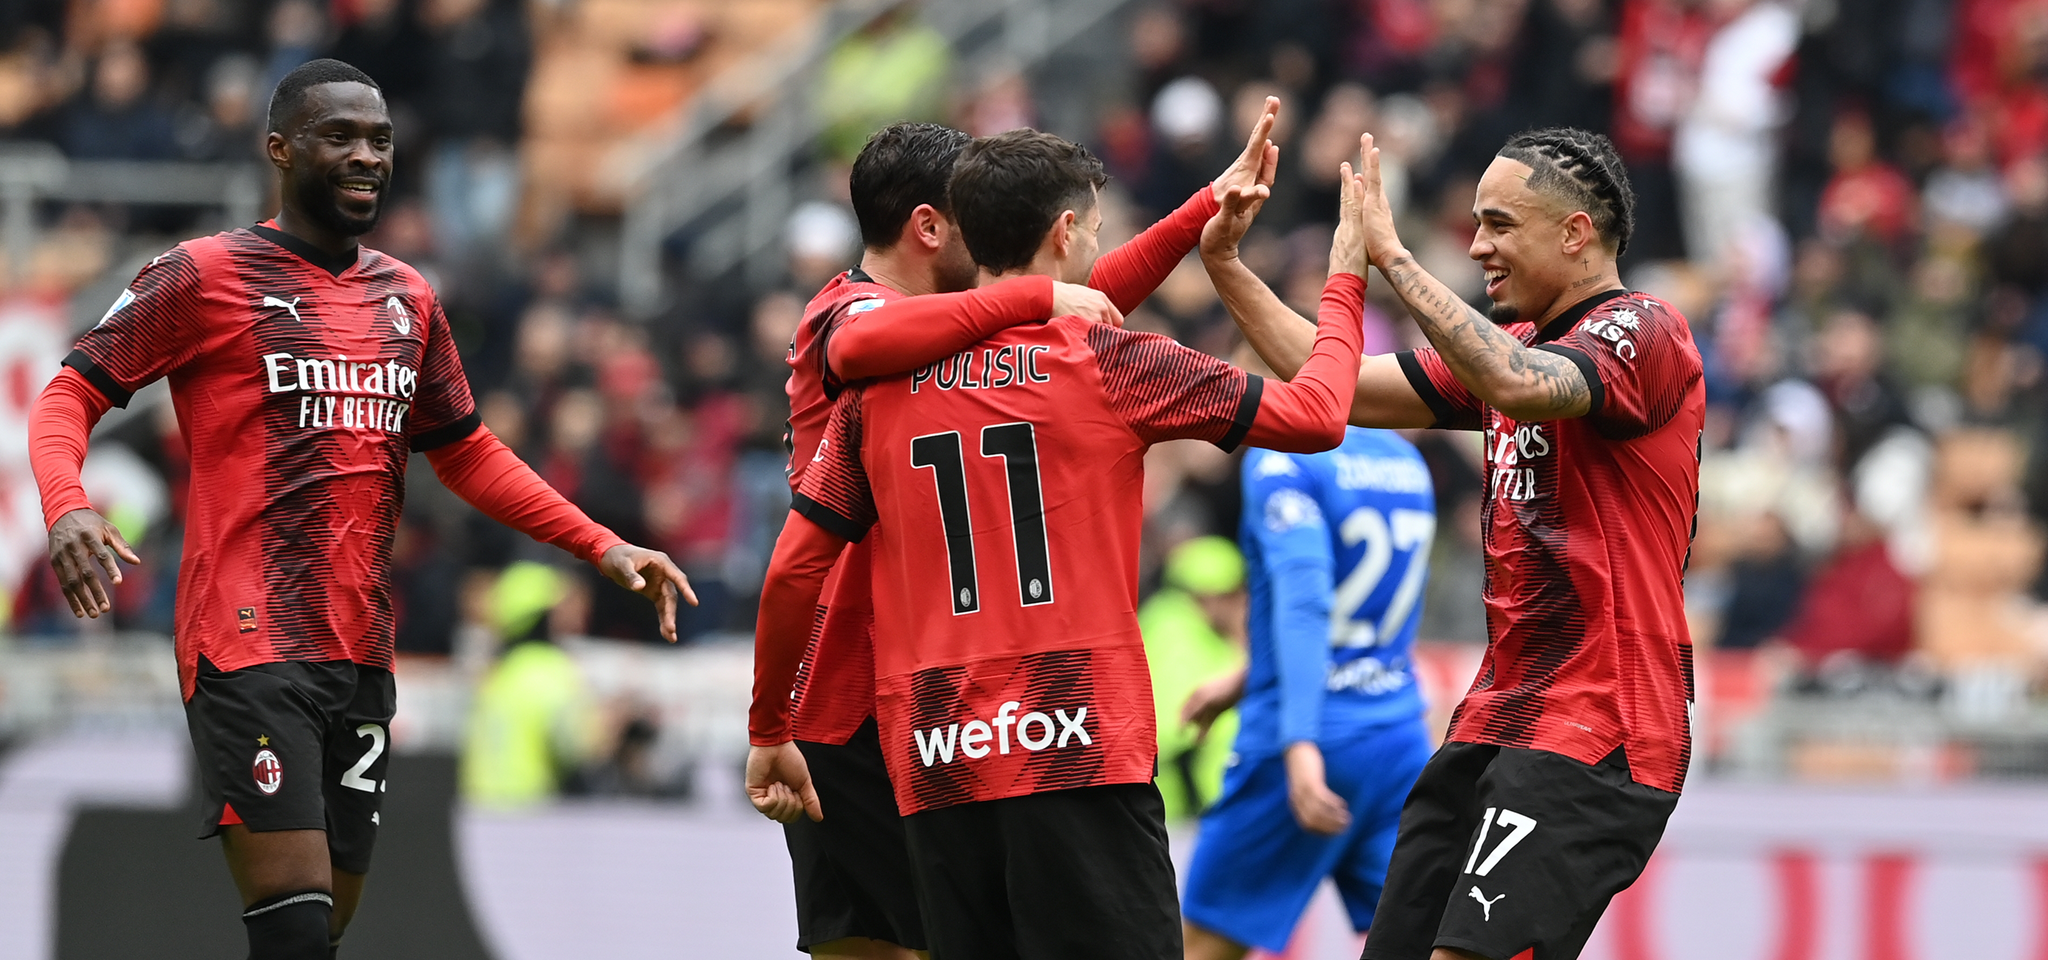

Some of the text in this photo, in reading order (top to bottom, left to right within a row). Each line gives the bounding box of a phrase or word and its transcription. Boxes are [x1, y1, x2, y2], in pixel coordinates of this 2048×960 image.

[911, 344, 1050, 394] PULISIC
[1579, 319, 1636, 362] MSC
[263, 352, 417, 401] Emirates
[299, 396, 409, 433] FLY BETTER
[911, 422, 1054, 616] 11
[1330, 507, 1437, 650] 27
[340, 723, 386, 793] 2
[913, 701, 1093, 767] wefox
[1464, 807, 1537, 876] 17
